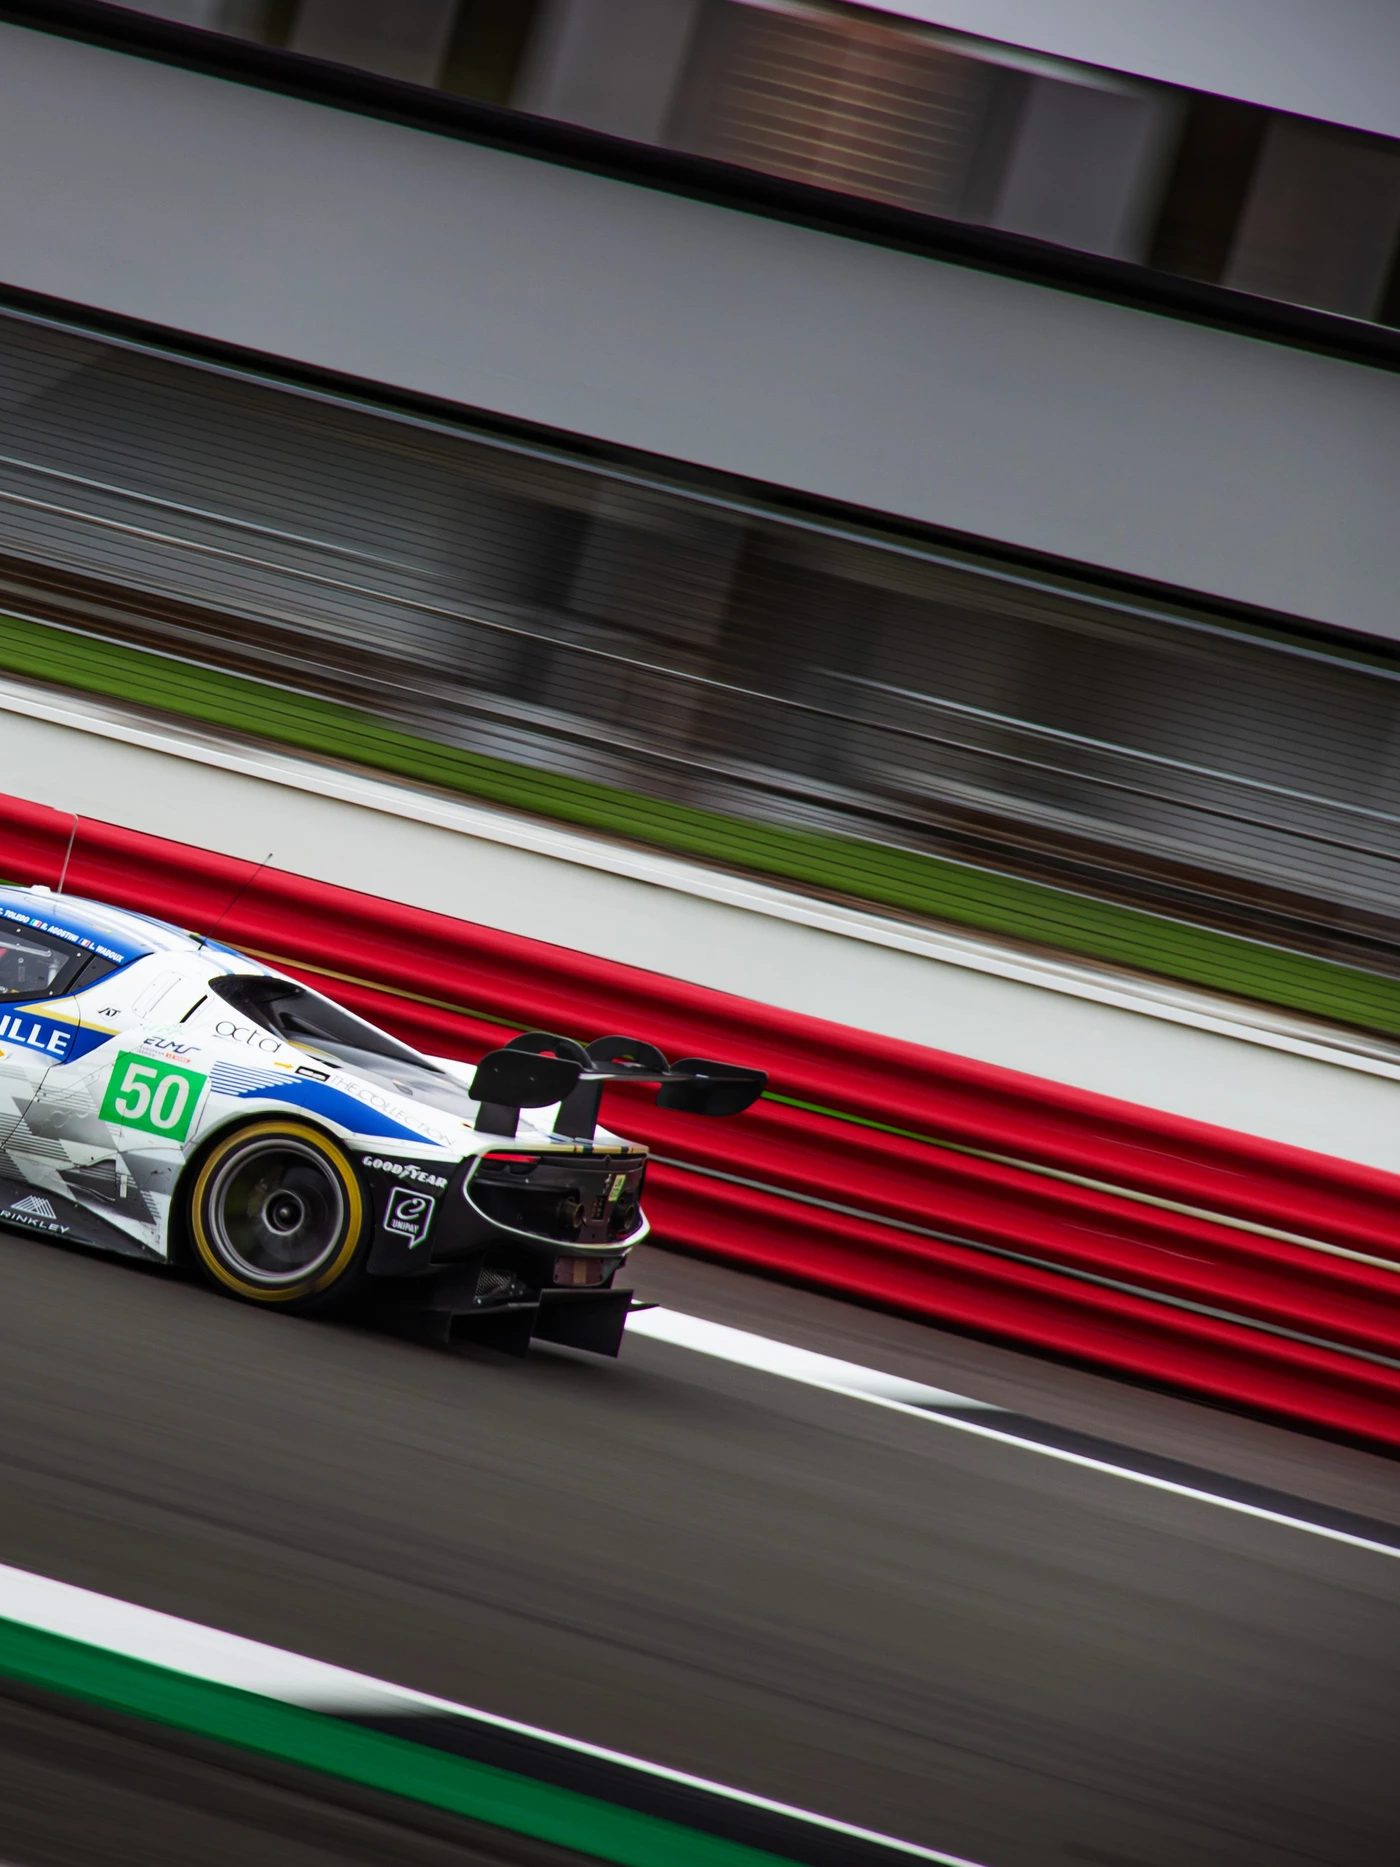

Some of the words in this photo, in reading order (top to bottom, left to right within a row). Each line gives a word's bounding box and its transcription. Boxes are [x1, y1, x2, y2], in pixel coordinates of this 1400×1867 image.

[4, 909, 30, 924] TOLEDO
[48, 925, 80, 943] AGOSTINI
[88, 942, 95, 950] L.
[95, 945, 124, 963] WADOUX
[143, 1036, 202, 1054] ELMS
[215, 1020, 282, 1053] octa
[115, 1062, 190, 1129] 50
[362, 1156, 448, 1189] GOODYEAR
[391, 1219, 420, 1235] UNIPAY
